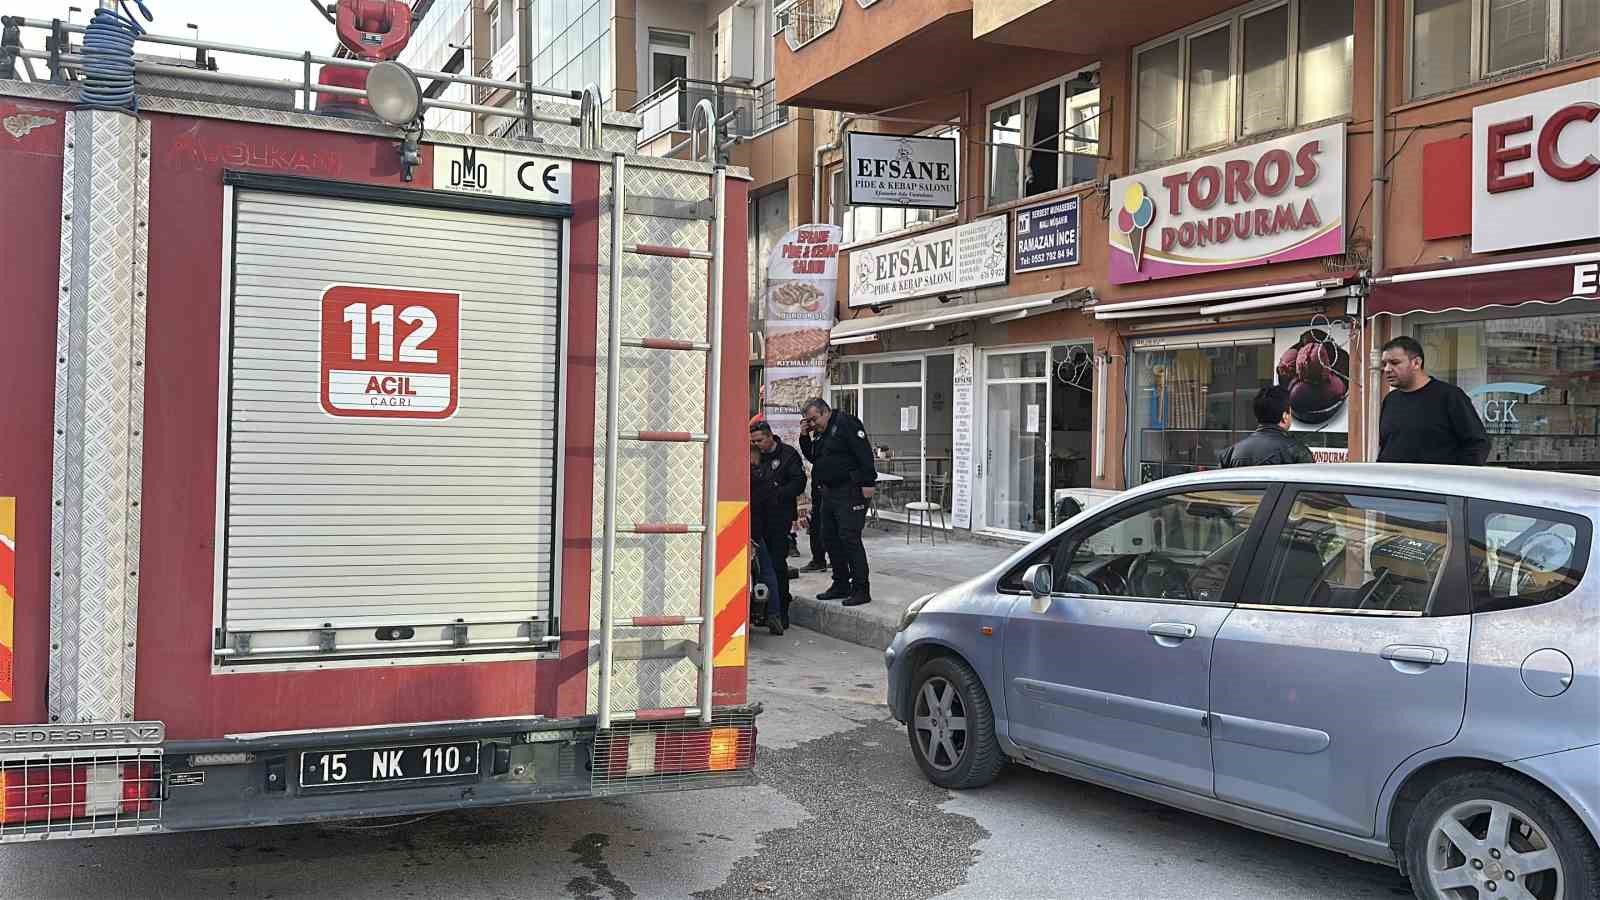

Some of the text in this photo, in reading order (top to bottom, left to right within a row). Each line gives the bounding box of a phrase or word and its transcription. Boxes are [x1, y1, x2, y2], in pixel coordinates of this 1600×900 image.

[517, 160, 560, 194] CE
[856, 158, 950, 181] EFSANE
[1162, 139, 1323, 217] TOROS
[878, 180, 886, 189] &
[887, 180, 918, 191] KEBAP
[919, 183, 953, 193] SALONU
[1031, 207, 1050, 219] SERBEST
[1161, 196, 1323, 252] DONDURMA
[1018, 229, 1076, 254] RAMAZAN İNCE
[875, 238, 954, 281] EFSANE
[891, 281, 897, 293] &
[898, 276, 922, 291] KEBAP
[924, 270, 953, 287] SALONU
[1571, 262, 1600, 296] E
[343, 302, 438, 364] 112
[364, 375, 417, 396] ACİL
[1478, 399, 1520, 423] GK
[319, 746, 460, 782] 15 NK 110
